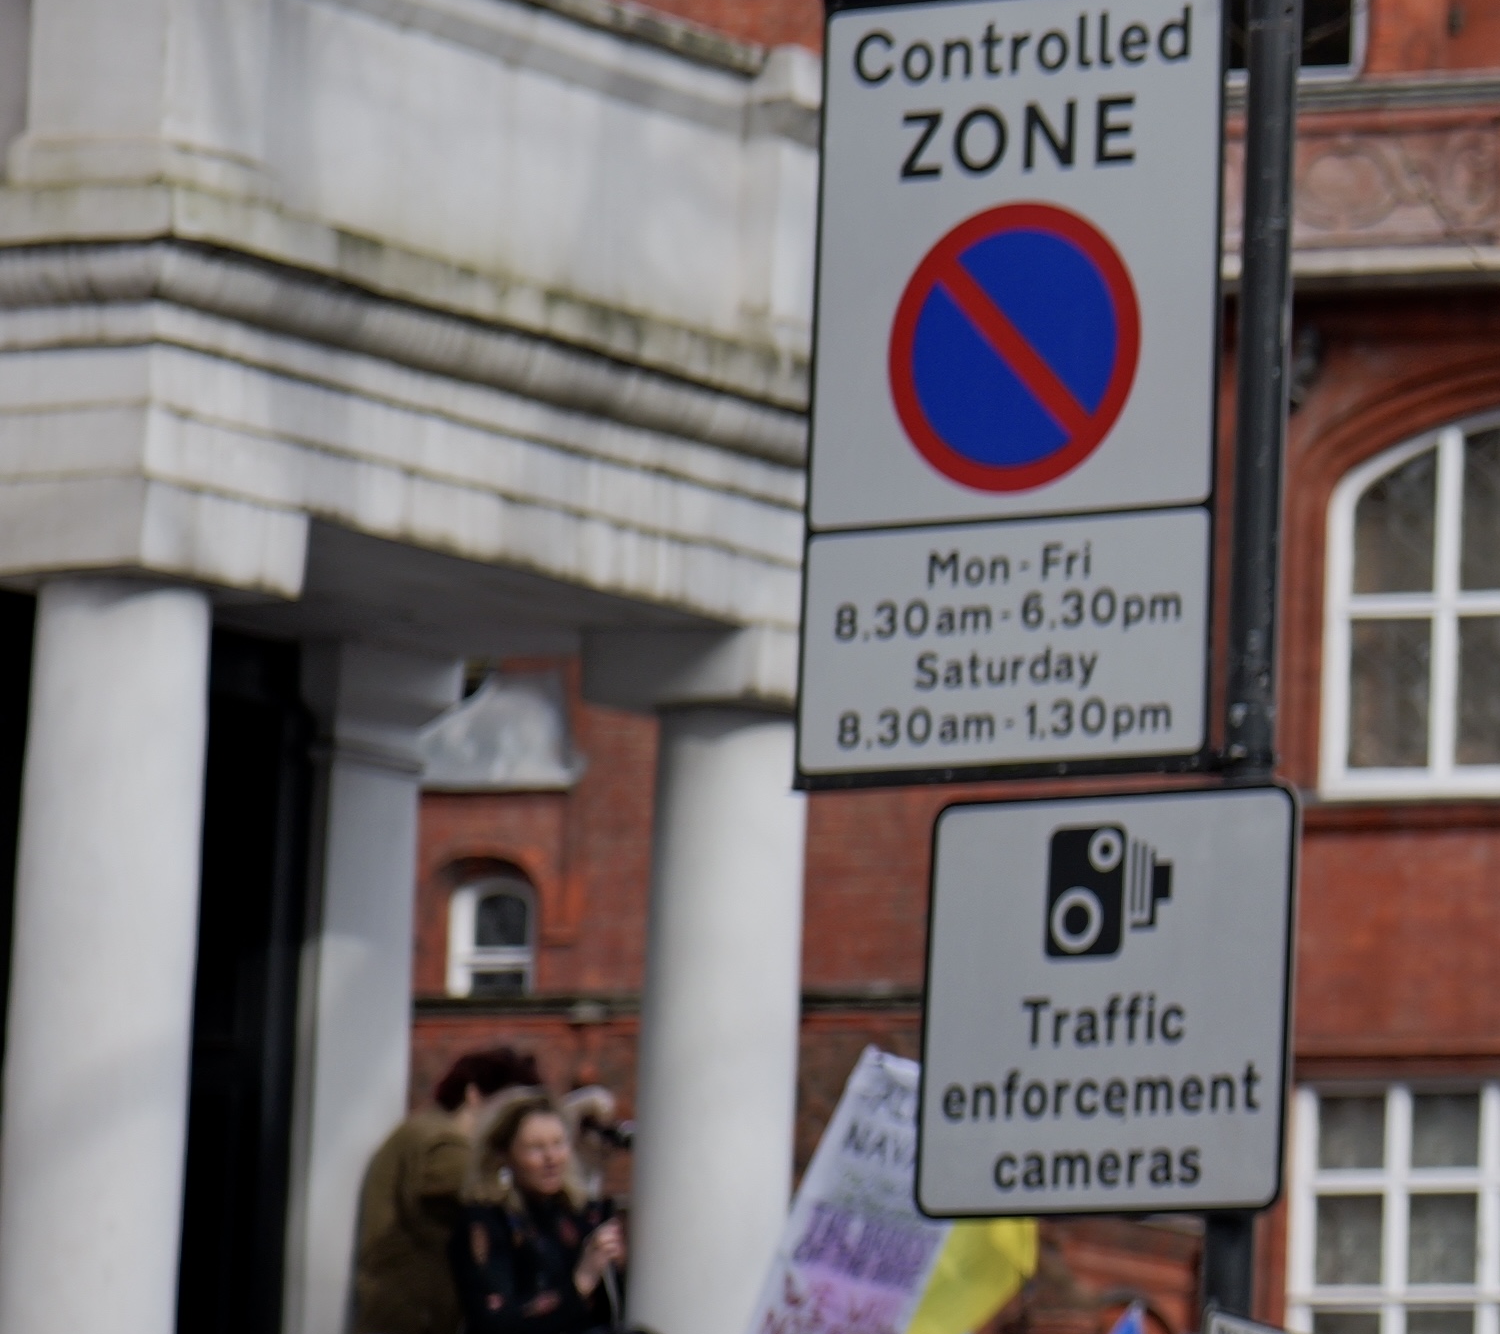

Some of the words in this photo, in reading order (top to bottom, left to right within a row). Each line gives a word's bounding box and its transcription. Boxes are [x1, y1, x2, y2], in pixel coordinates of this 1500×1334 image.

[854, 1, 1193, 84] Controlled
[900, 93, 1136, 179] ZONE
[926, 548, 1010, 588] Mon
[1041, 541, 1092, 581] Fri
[834, 597, 994, 643] 8.30am
[1020, 585, 1184, 631] 6.30pm
[914, 644, 1098, 691] Saturday
[836, 706, 996, 751] 8.30am
[1025, 696, 1174, 742] 1.30pm
[1021, 990, 1187, 1048] Traffic
[942, 1061, 1262, 1122] enforcement
[993, 1145, 1201, 1192] cameras
